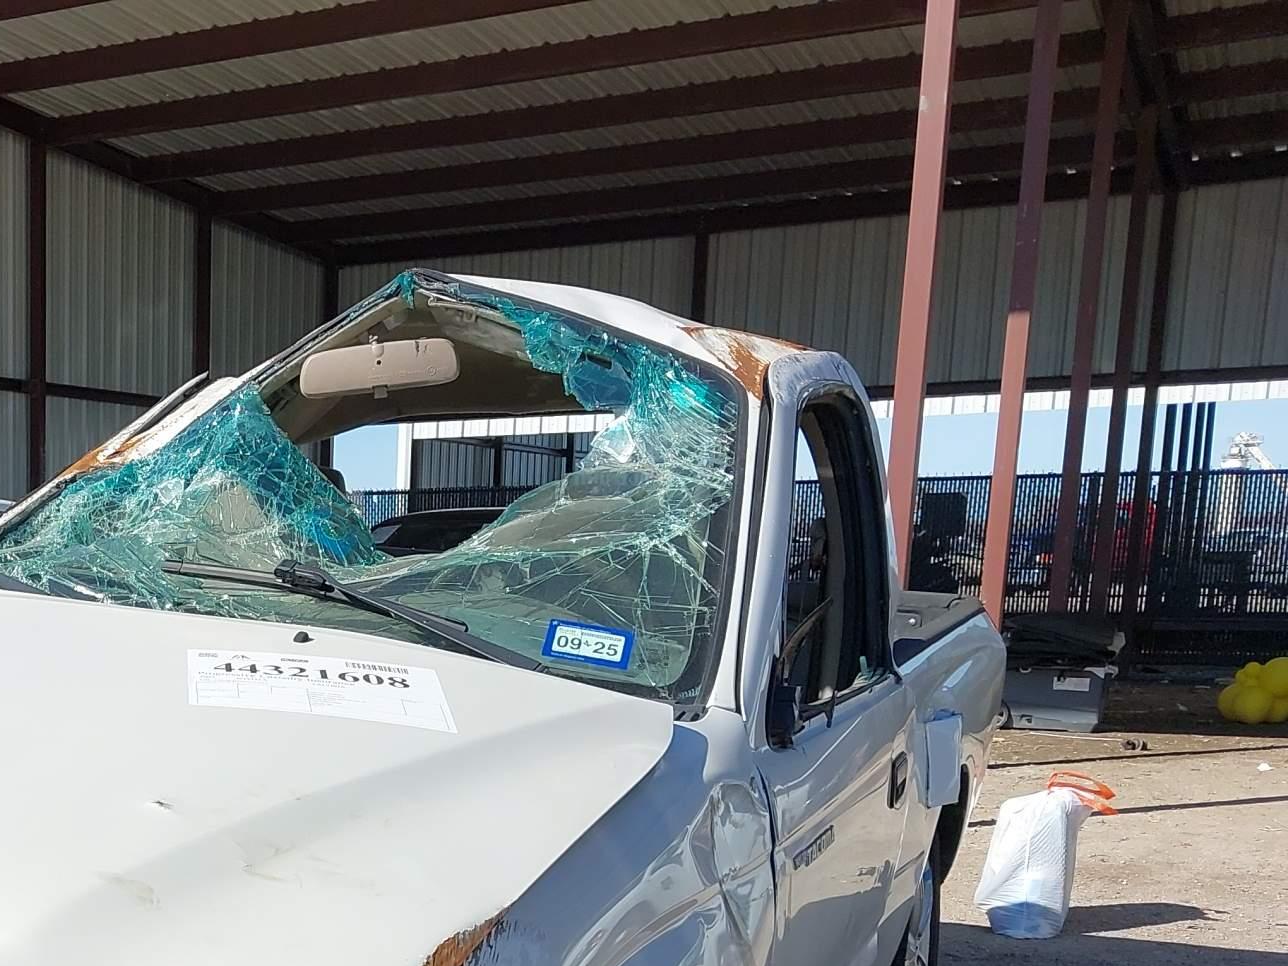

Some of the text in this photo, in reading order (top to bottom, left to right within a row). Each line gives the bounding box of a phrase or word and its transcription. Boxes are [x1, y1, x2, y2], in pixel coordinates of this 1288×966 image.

[557, 635, 582, 650] 09
[592, 641, 619, 657] 25
[213, 662, 410, 689] 44321608
